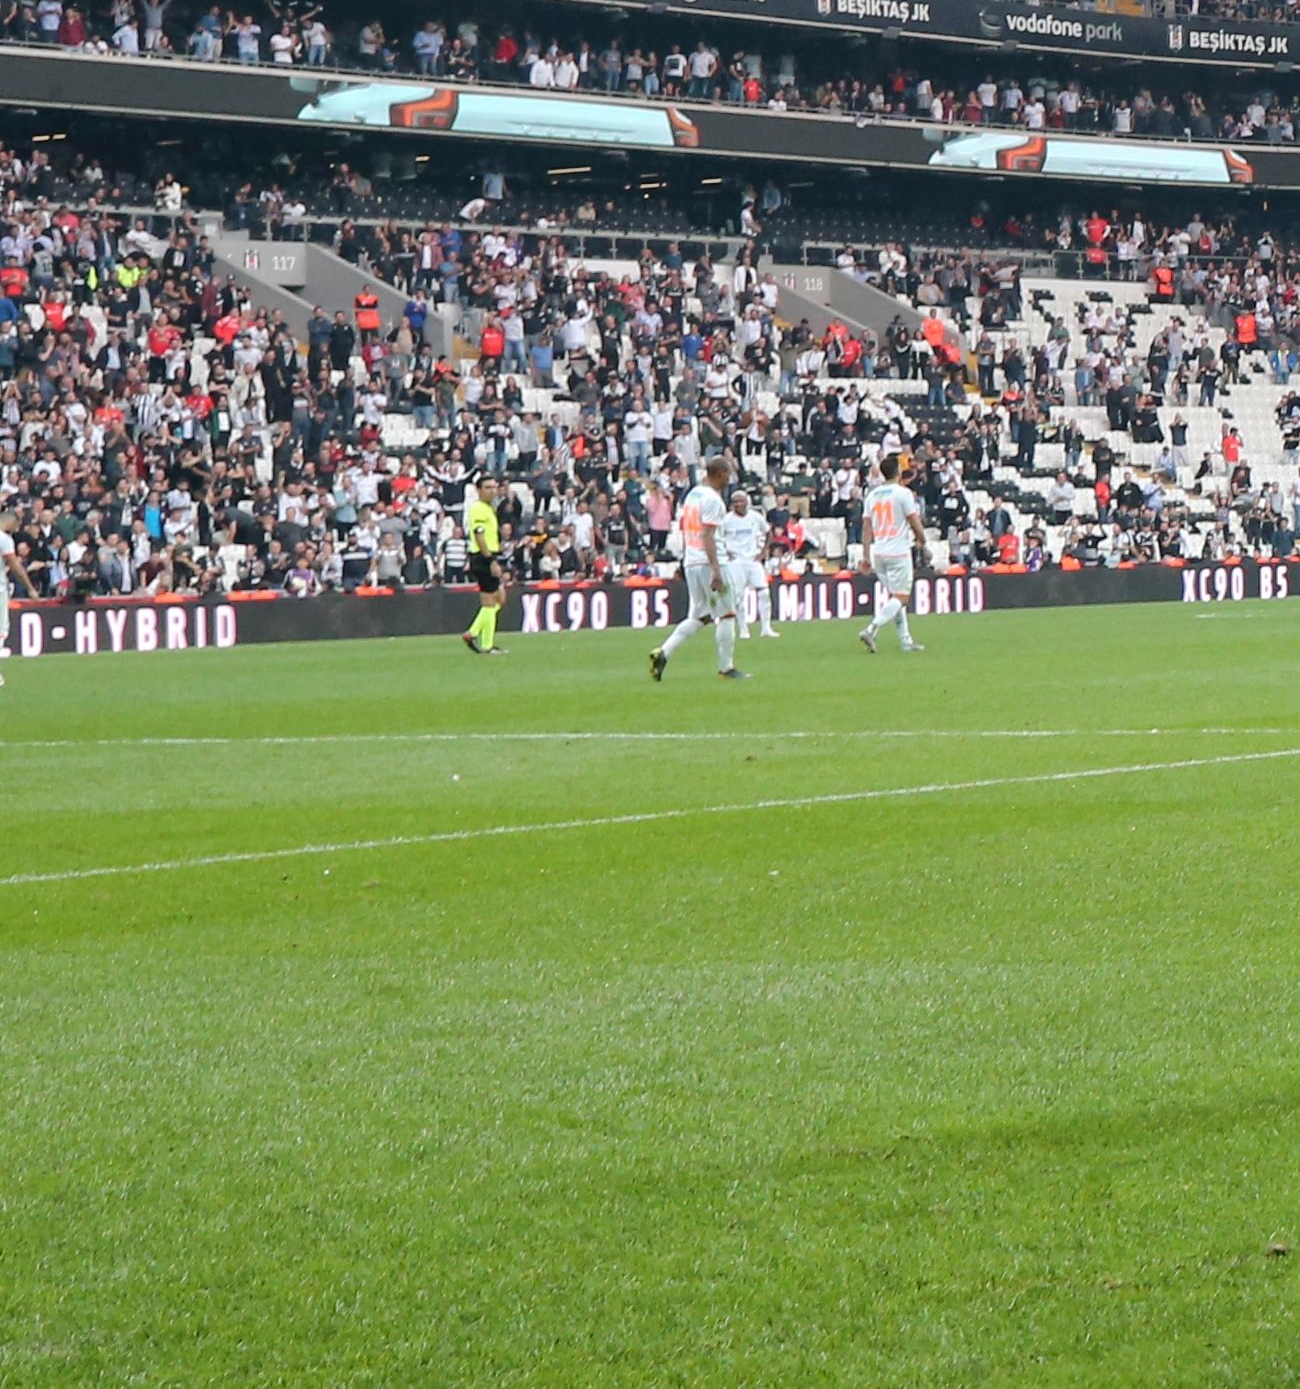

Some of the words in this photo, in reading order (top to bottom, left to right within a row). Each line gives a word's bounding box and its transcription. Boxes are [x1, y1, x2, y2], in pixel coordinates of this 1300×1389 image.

[909, 2, 930, 22] JK
[1005, 12, 1082, 39] vodafone
[1085, 22, 1122, 43] park
[1189, 29, 1266, 55] BEŞİKTAŞ
[1267, 34, 1289, 55] JK
[271, 256, 296, 270] 117
[804, 278, 824, 292] 118
[1182, 567, 1244, 601] XC90
[1260, 565, 1288, 598] B5
[522, 590, 608, 633] XC90
[631, 588, 670, 629] B5
[0, 605, 237, 658] D-HYBRID
